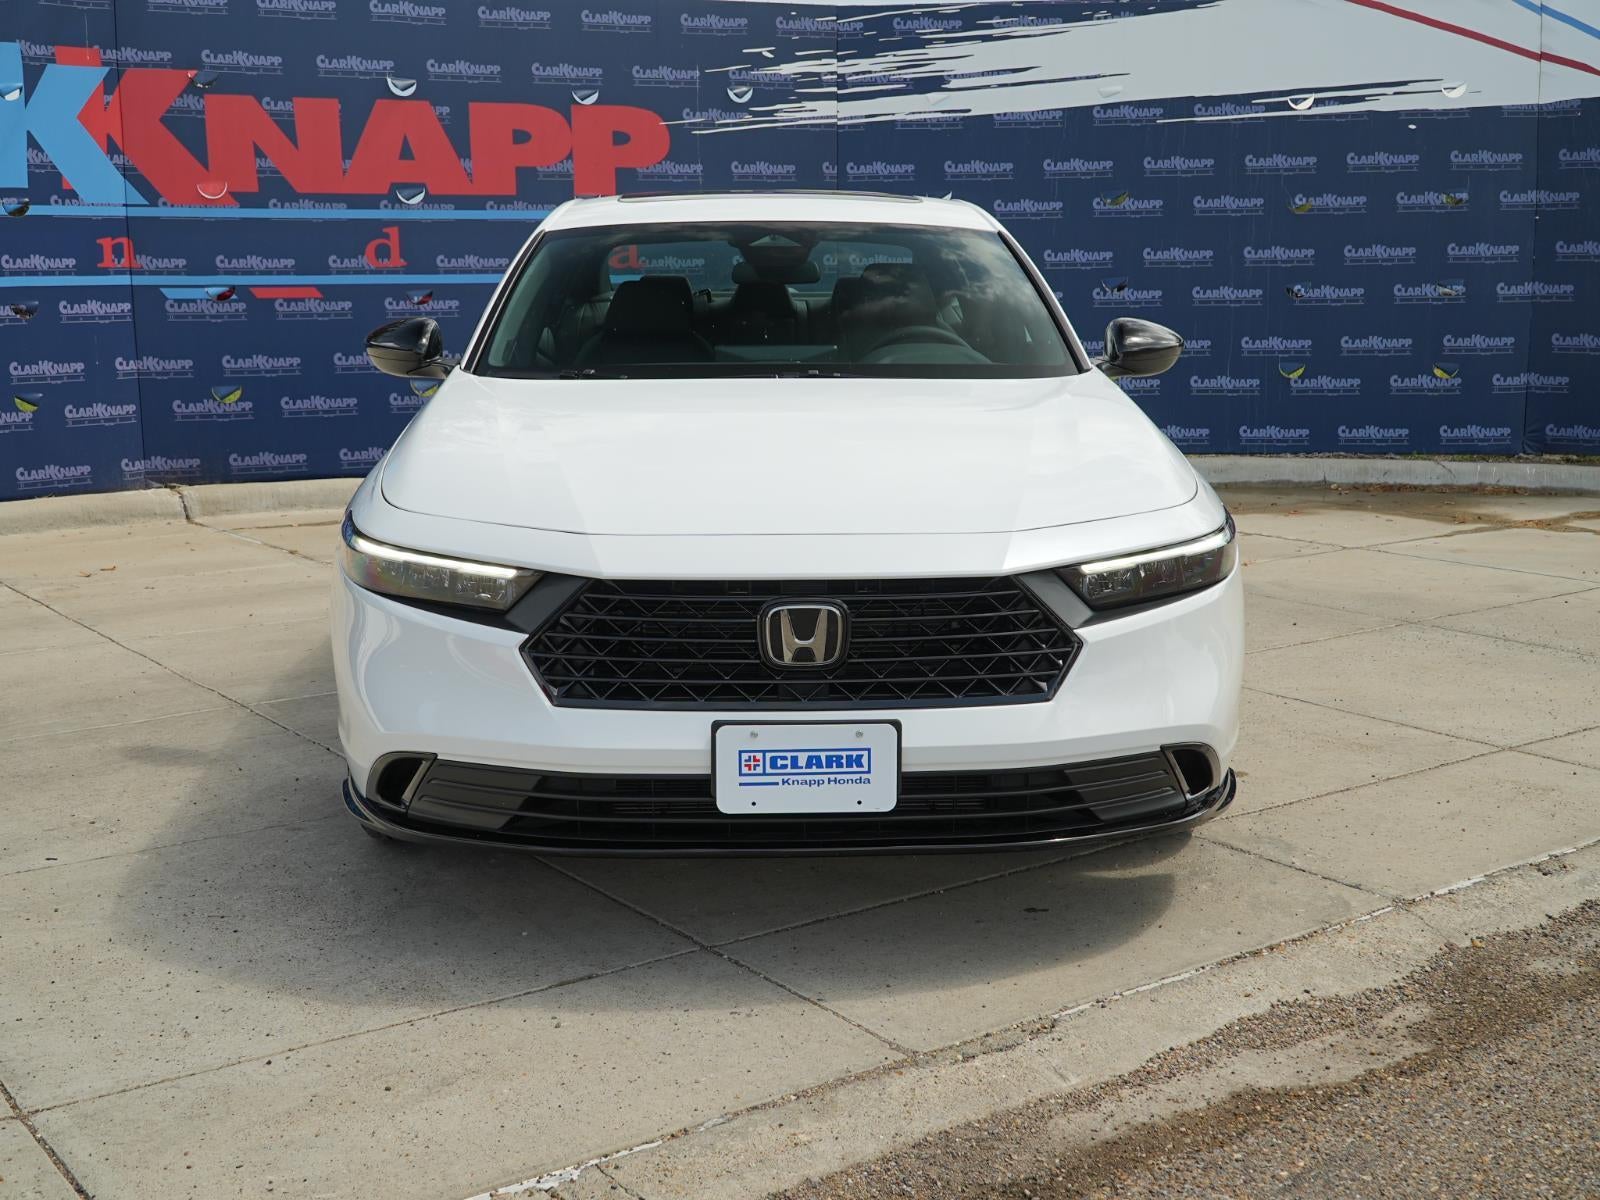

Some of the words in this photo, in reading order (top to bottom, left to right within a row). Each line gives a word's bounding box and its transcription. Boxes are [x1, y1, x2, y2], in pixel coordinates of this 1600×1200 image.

[769, 753, 865, 770] CLARK
[781, 777, 825, 787] Knapp
[827, 776, 871, 786] Honda
